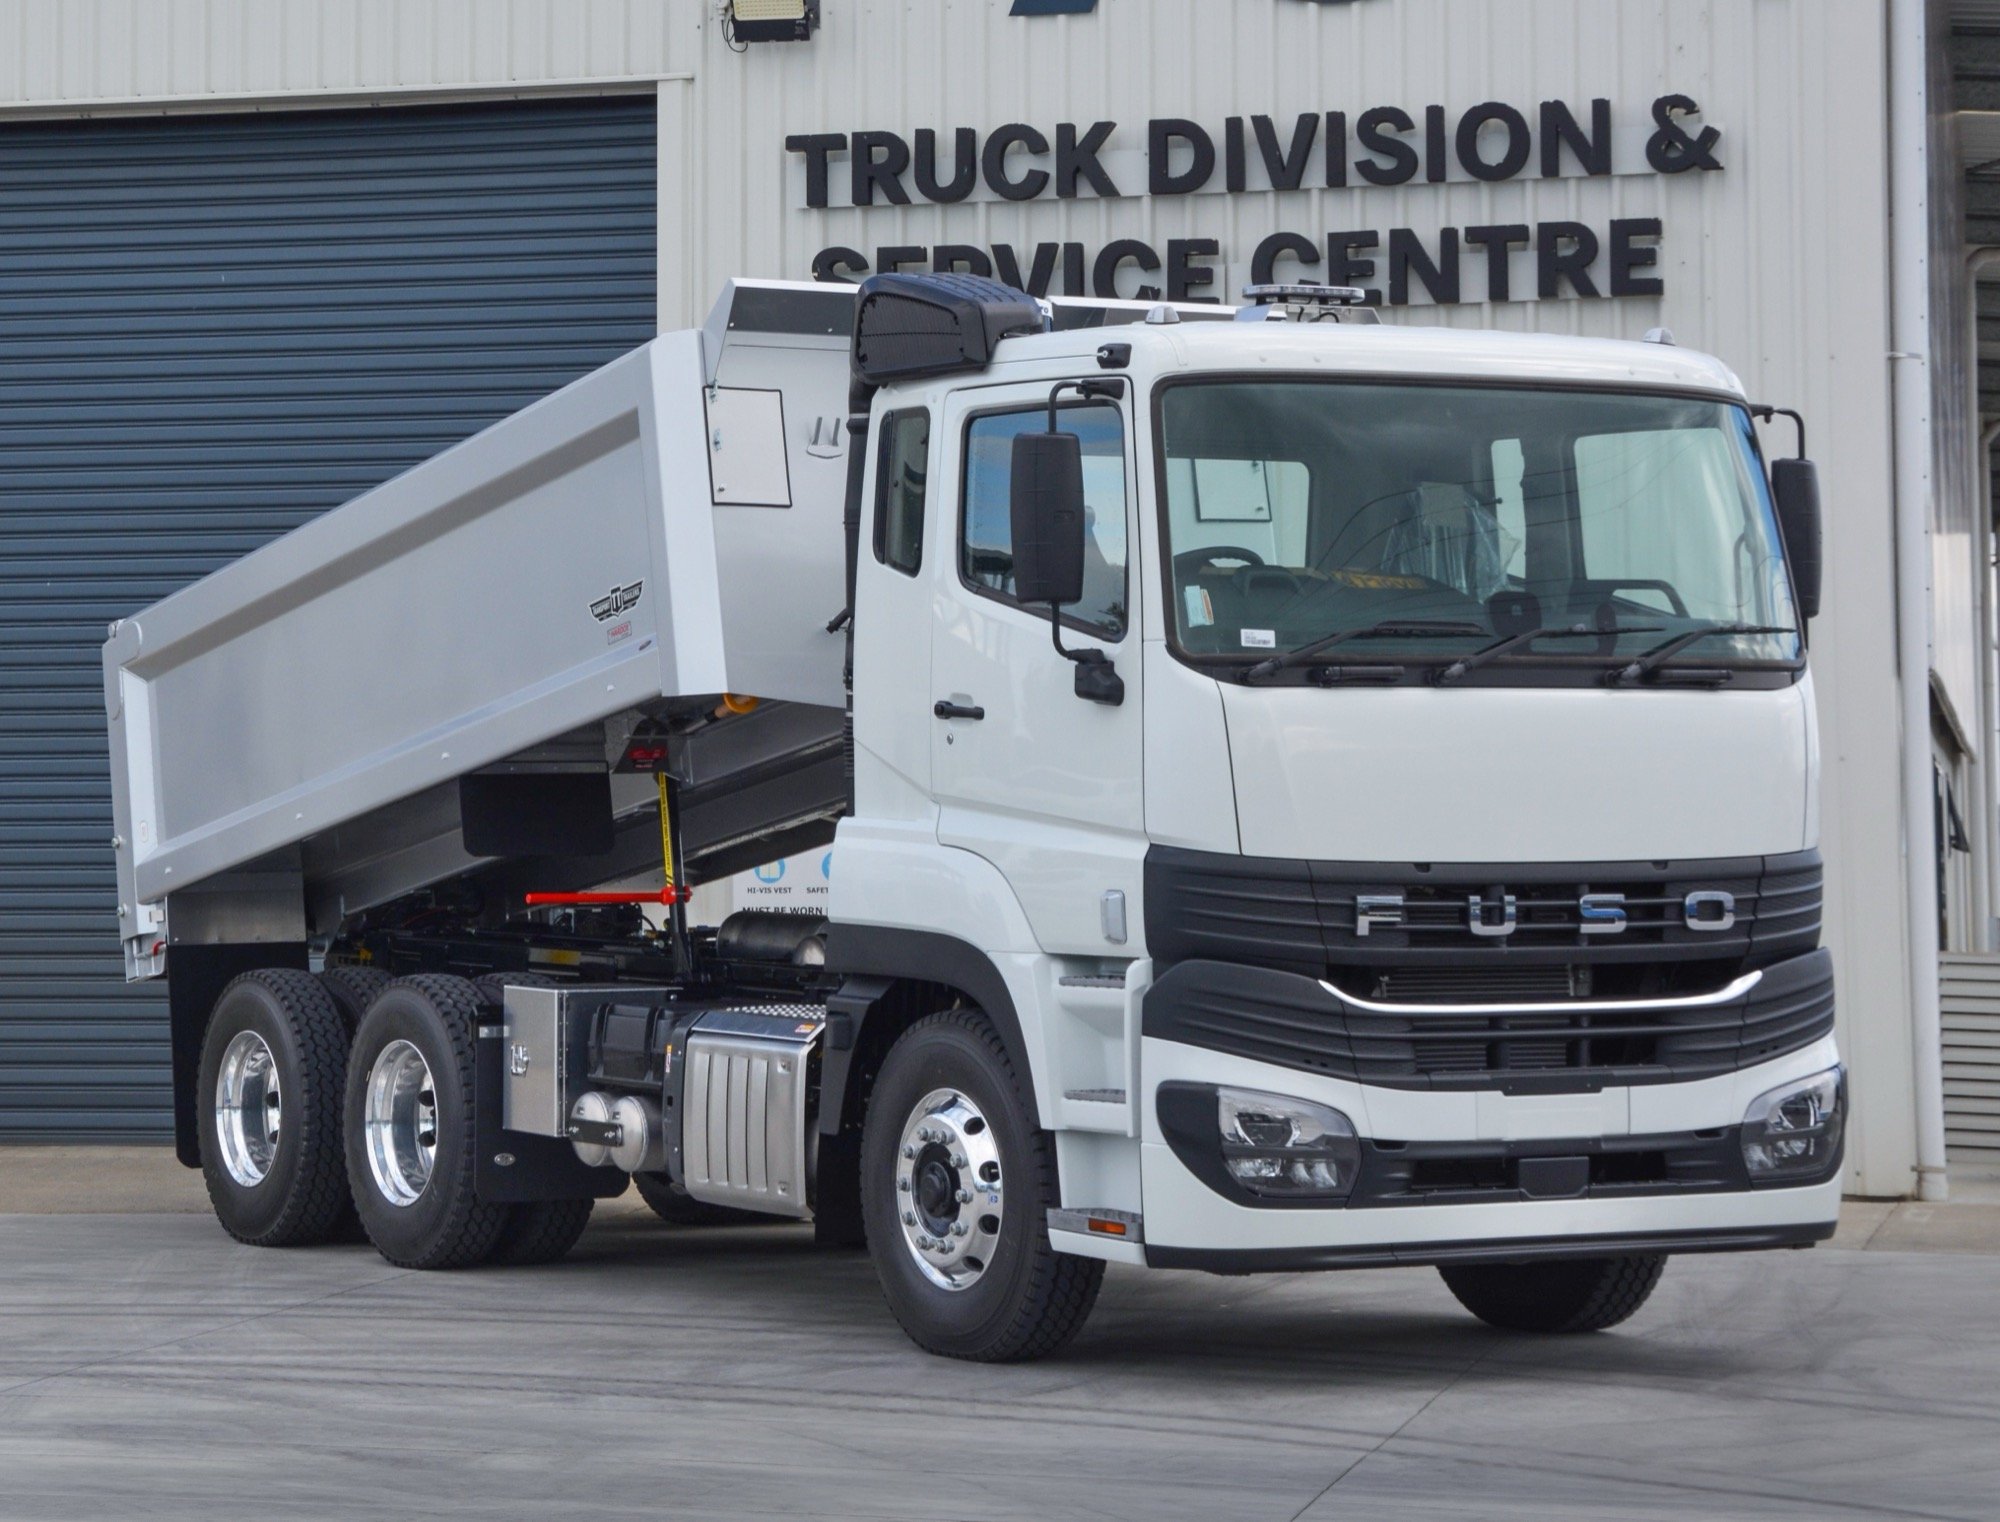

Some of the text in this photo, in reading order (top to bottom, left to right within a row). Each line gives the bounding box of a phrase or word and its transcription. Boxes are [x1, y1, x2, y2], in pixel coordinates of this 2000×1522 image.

[785, 94, 1724, 208] TRUCK DIVISION &
[1251, 218, 1664, 305] CENTRE
[790, 906, 822, 915] WORN
[1356, 891, 1735, 936] FUSO
